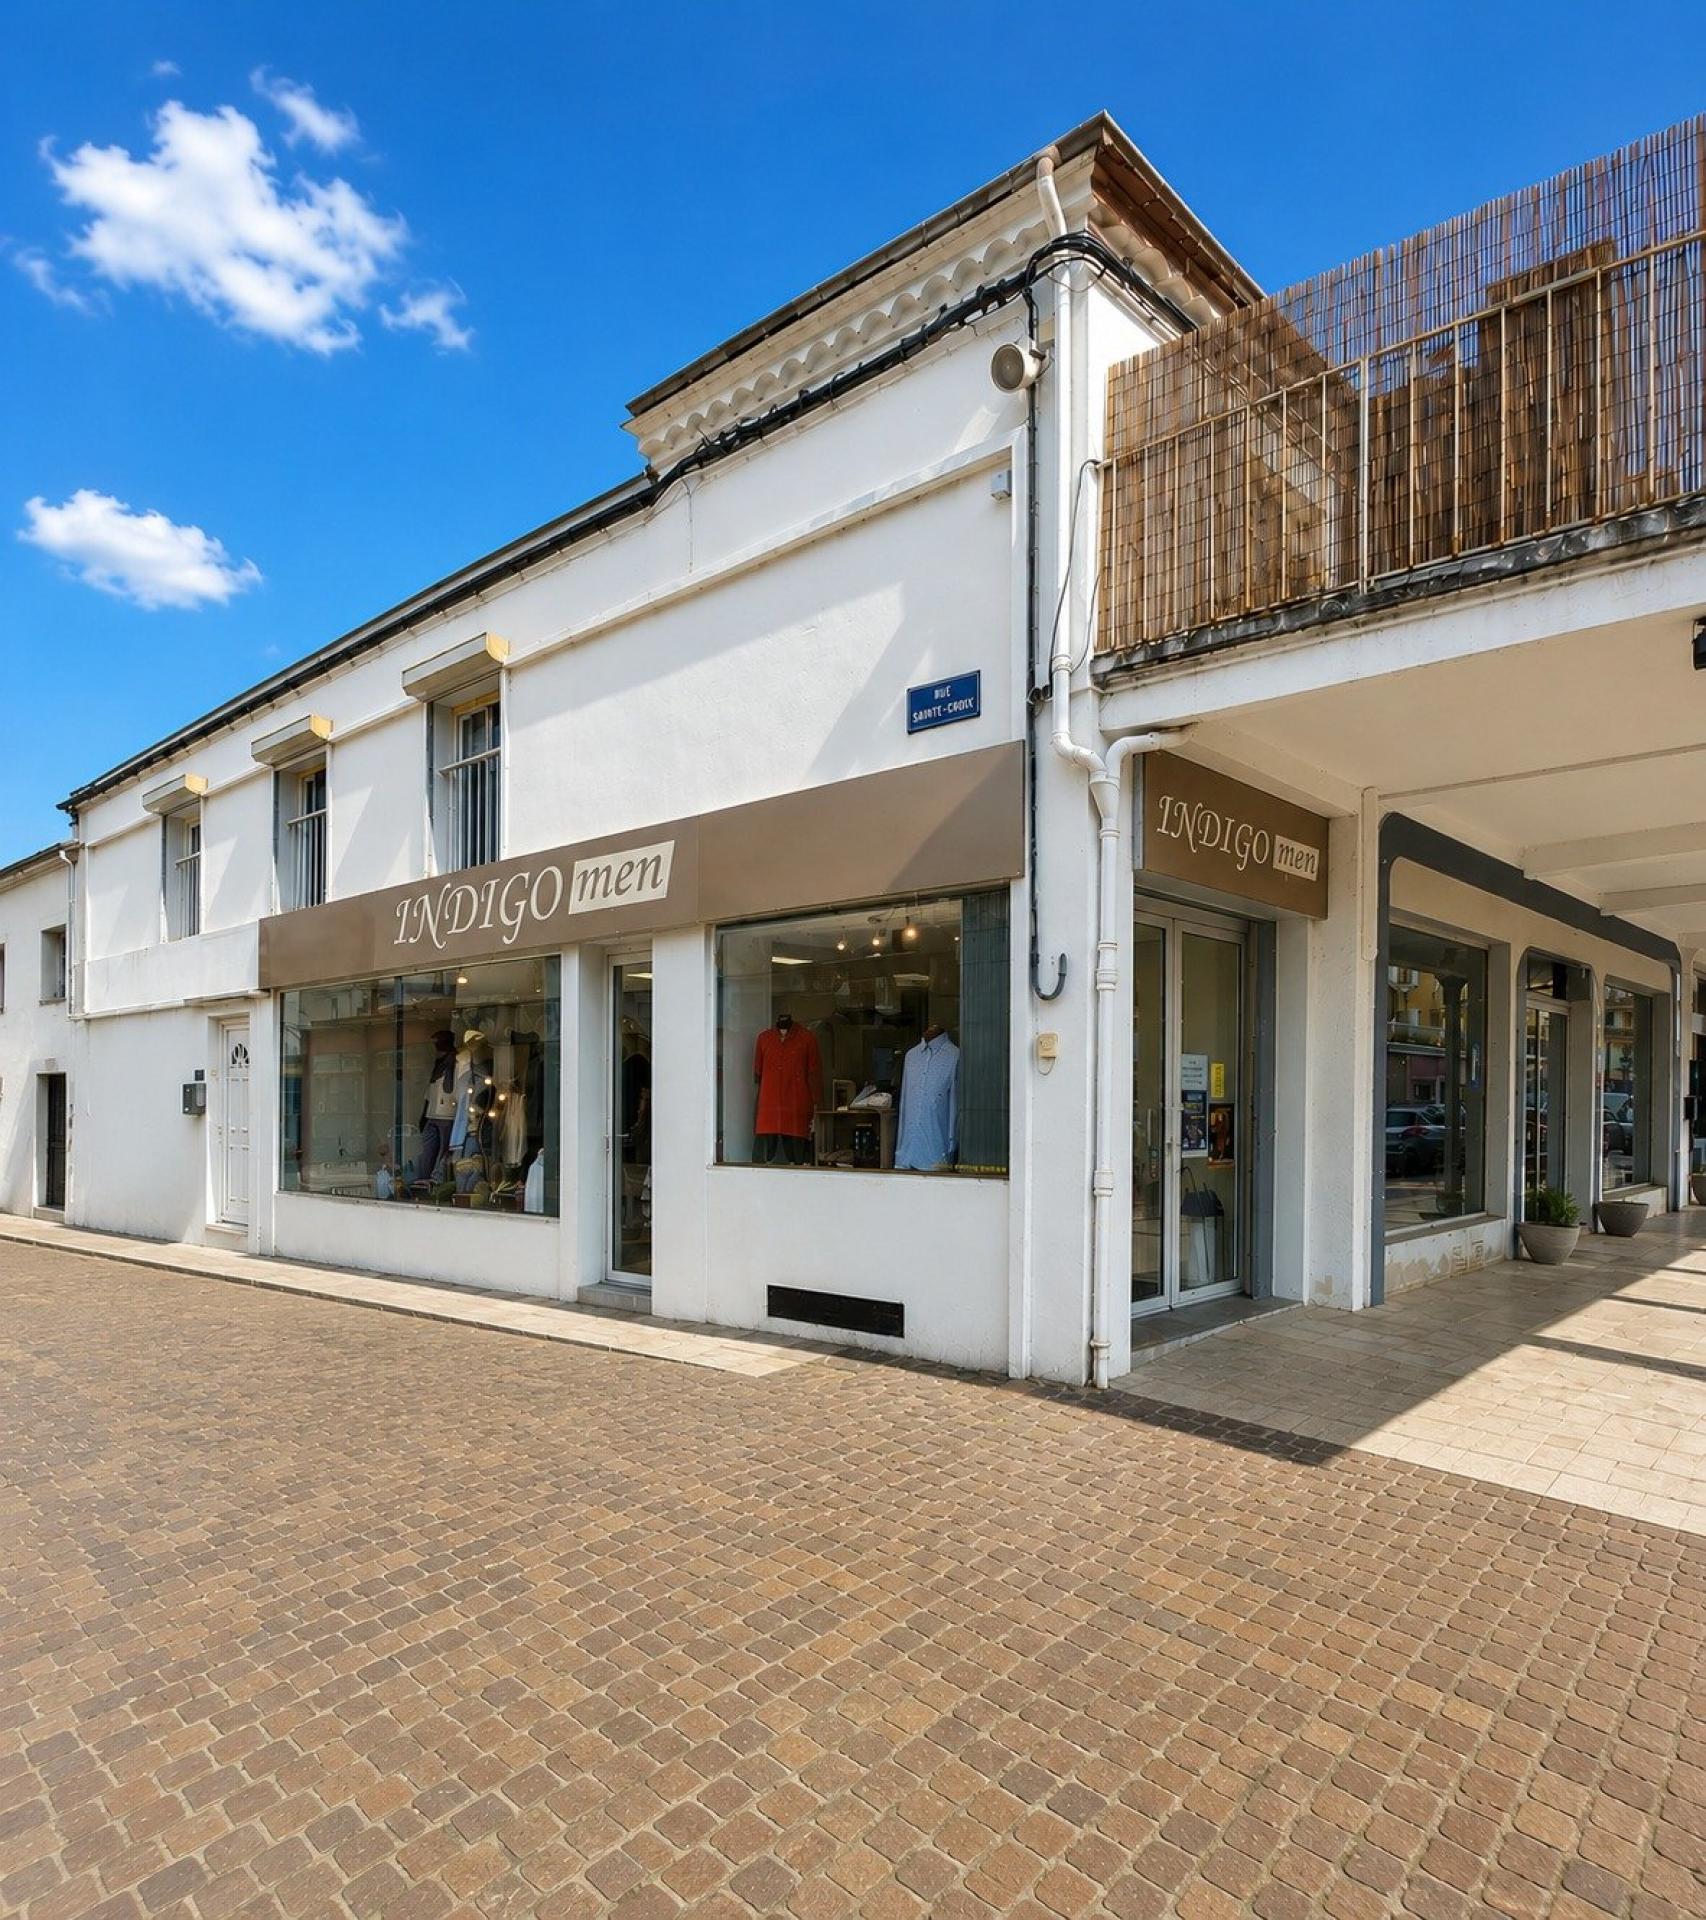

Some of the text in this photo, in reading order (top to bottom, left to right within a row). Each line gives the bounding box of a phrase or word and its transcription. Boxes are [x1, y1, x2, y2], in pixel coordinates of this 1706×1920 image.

[912, 697, 974, 723] SAINTE-CROIX
[934, 685, 951, 700] RUE
[1157, 795, 1316, 875] INDIGO men
[393, 854, 664, 950] INDIGO men
